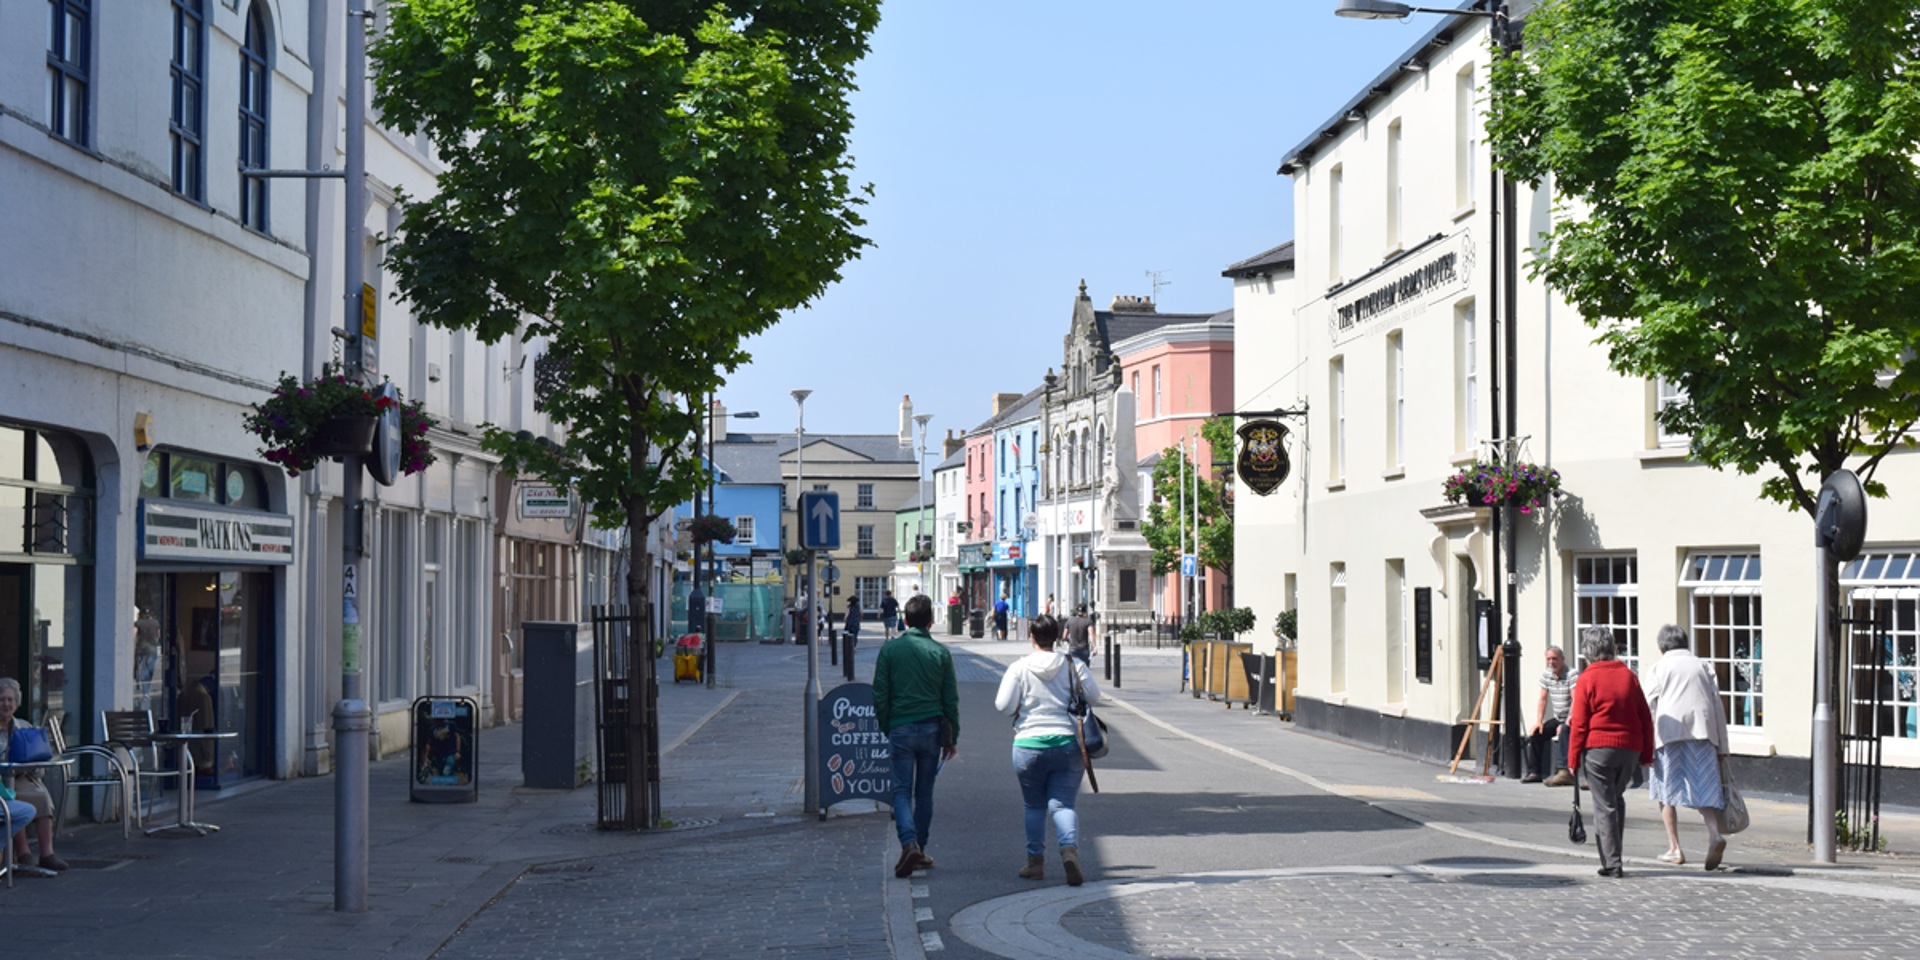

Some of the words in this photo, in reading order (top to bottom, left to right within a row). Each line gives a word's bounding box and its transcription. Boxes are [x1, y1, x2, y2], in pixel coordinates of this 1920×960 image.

[1337, 303, 1353, 330] THE
[1398, 267, 1423, 302] ARMS
[1424, 251, 1456, 289] HOTEL
[200, 517, 252, 552] WATKINS
[833, 697, 876, 719] Prou
[832, 732, 890, 745] COFFEE
[871, 748, 890, 759] us
[846, 779, 891, 794] YOU!
